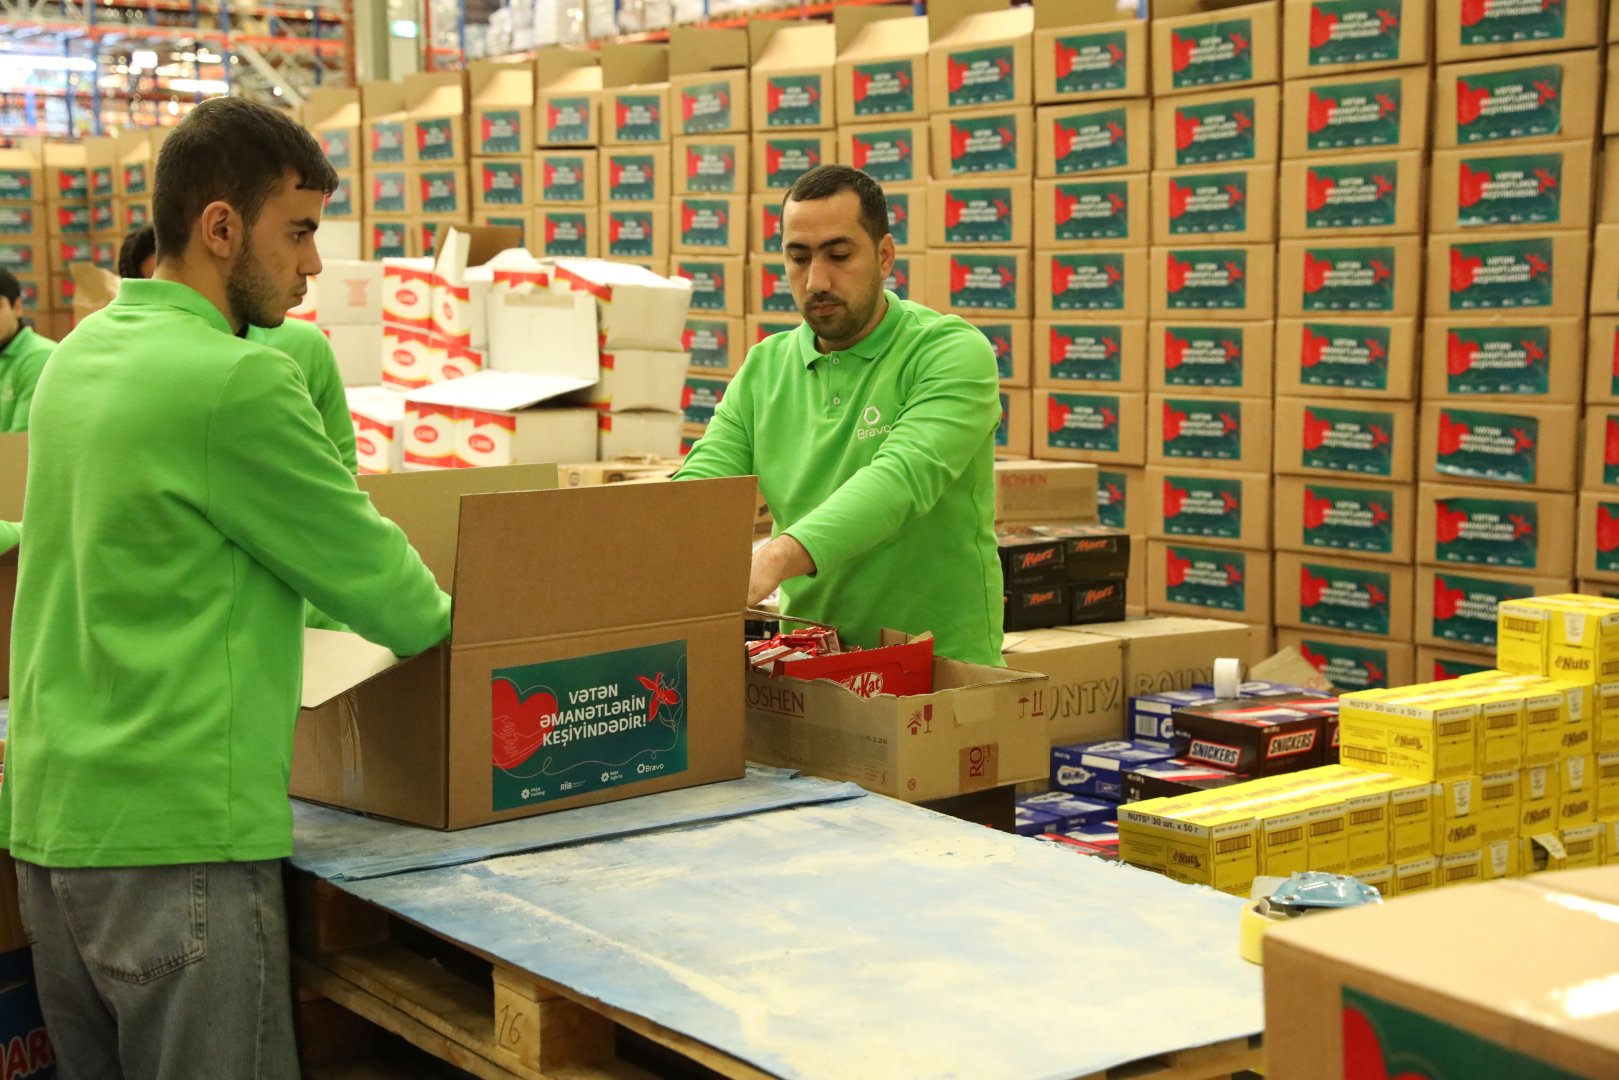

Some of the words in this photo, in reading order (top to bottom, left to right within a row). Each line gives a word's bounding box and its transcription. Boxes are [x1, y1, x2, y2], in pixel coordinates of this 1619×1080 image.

[857, 425, 891, 439] Bravo
[1561, 656, 1590, 670] Nuts
[568, 684, 618, 705] VƏTƏN
[745, 683, 805, 714] OSHEN
[539, 696, 646, 729] ƏMANƏTLƏRİN
[542, 713, 647, 747] KEŞİYİNDƏDİR!
[1191, 742, 1238, 765] SNICKERS
[1270, 733, 1313, 754] SNICKERS
[645, 763, 664, 772] Bravo
[1152, 817, 1161, 826] 30
[1183, 823, 1193, 833] 50
[1178, 851, 1201, 867] Nuts
[499, 1004, 523, 1047] 16
